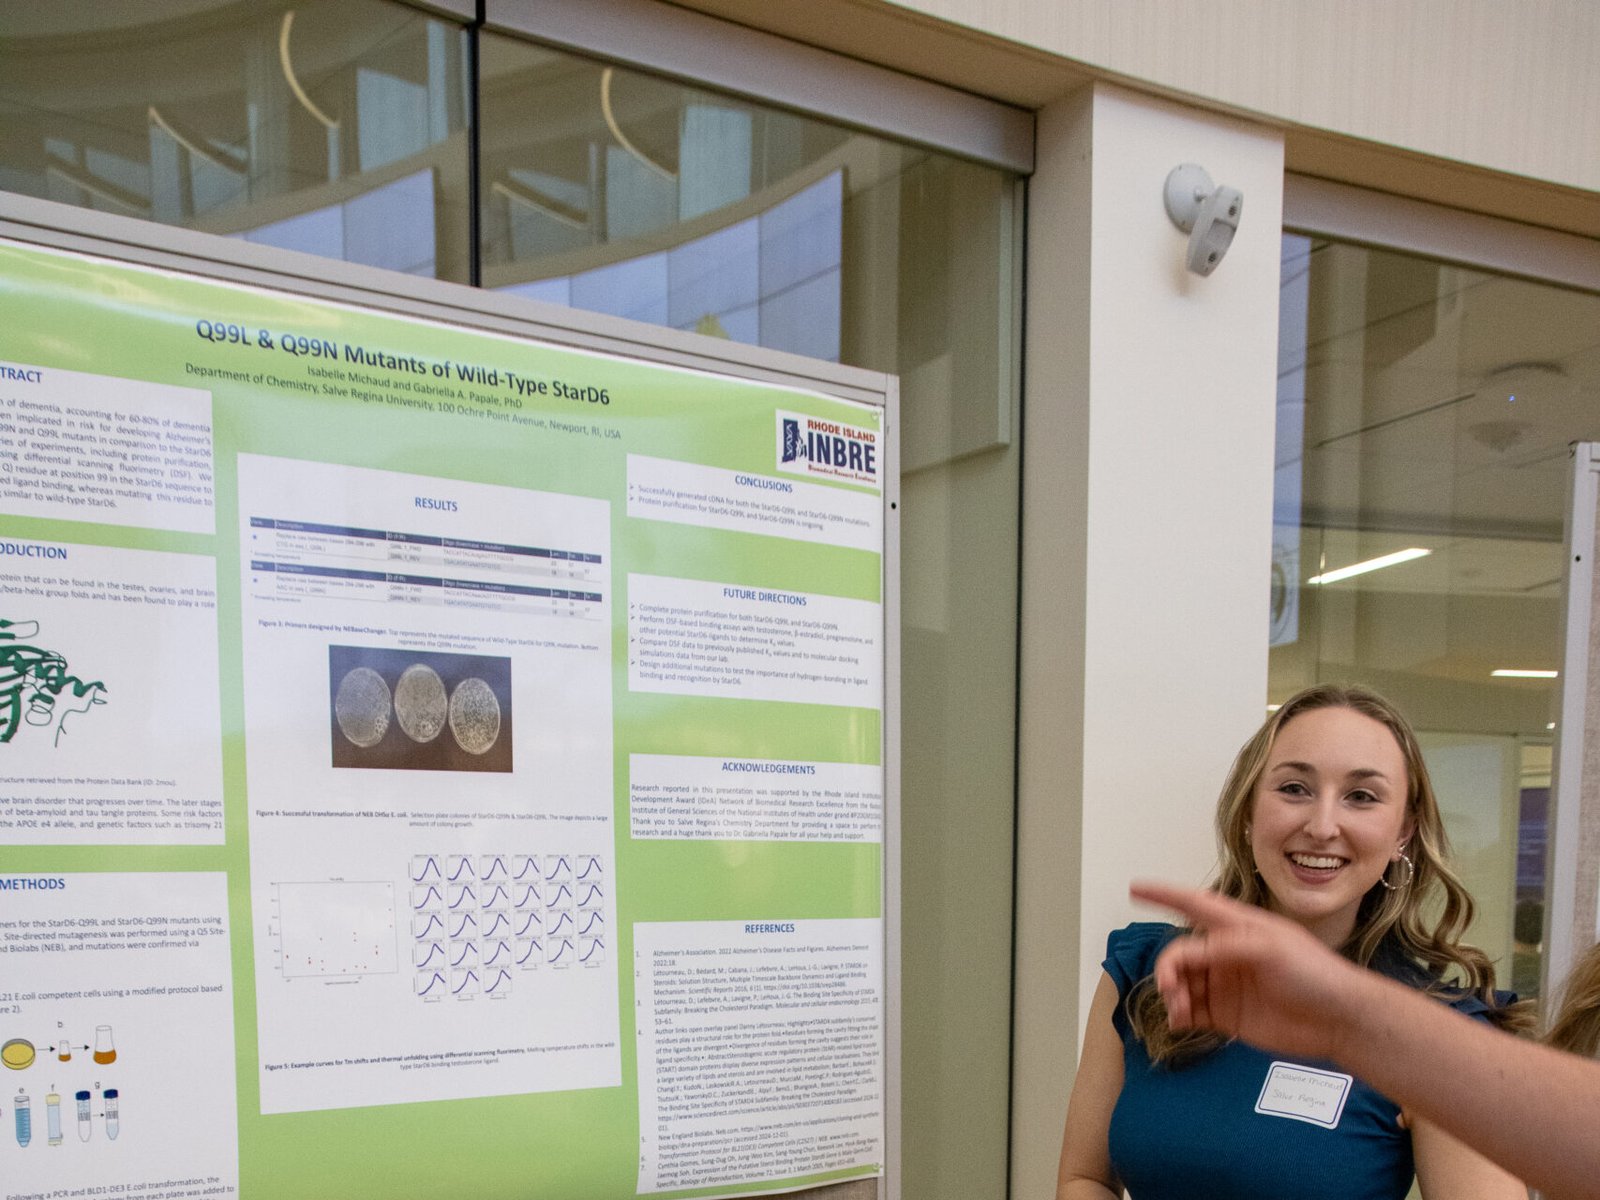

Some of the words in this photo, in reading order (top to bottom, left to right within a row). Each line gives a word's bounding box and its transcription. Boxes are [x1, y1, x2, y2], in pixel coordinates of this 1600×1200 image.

[196, 321, 252, 346] Q99L
[258, 331, 275, 350] &
[281, 335, 338, 361] Q99N
[344, 346, 427, 375] Mutants
[432, 362, 451, 379] of
[457, 365, 548, 397] Wild-Type
[553, 381, 610, 406] StarD6
[0, 367, 42, 383] TRACT
[307, 365, 346, 380] Isabelle
[348, 372, 391, 387] Michaud
[393, 381, 411, 390] and
[413, 382, 455, 397] Gabriella
[504, 396, 523, 408] PhD
[185, 364, 251, 383] Department
[253, 375, 264, 385] of
[323, 385, 349, 398] Salve
[351, 389, 384, 403] Regina
[438, 402, 456, 414] 100
[457, 405, 485, 418] Ochre
[487, 410, 510, 422] Point
[604, 428, 621, 439] USA
[7, 400, 16, 408] of
[66, 409, 112, 422] accounting
[114, 412, 126, 422] for
[129, 414, 160, 426] 60-80%
[162, 419, 171, 427] of
[173, 419, 211, 432] dementia
[808, 420, 841, 435] RHODE
[843, 428, 875, 442] ISLAND
[808, 431, 876, 474] INBRE
[735, 475, 793, 493] CONCLUSIONS
[4, 490, 32, 500] similar
[34, 493, 44, 501] to
[46, 494, 86, 506] wild-type
[415, 497, 458, 512] RESULTS
[24, 575, 41, 584] that
[59, 577, 70, 586] be
[72, 578, 95, 588] found
[97, 580, 105, 588] in
[107, 581, 120, 589] the
[180, 586, 194, 595] and
[196, 587, 215, 596] brain
[723, 588, 756, 601] FUTURE
[758, 592, 807, 606] DIRECTIONS
[722, 762, 816, 775] ACKNOWLEDGEMENTS
[5, 808, 14, 816] of
[16, 808, 67, 818] beta-amyloid
[101, 809, 125, 818] tangle
[161, 809, 182, 817] Some
[183, 809, 196, 817] risk
[198, 809, 222, 817] factors
[16, 820, 38, 828] APOE
[41, 820, 51, 828] e4
[96, 821, 124, 830] genetic
[154, 821, 172, 829] such
[184, 821, 211, 830] trisomy
[214, 821, 222, 829] 21
[0, 879, 65, 890] METHODS
[18, 919, 30, 927] for
[32, 918, 47, 927] the
[48, 917, 99, 927] StarD6-Q99L
[101, 917, 116, 925] and
[117, 916, 169, 925] StarD6-Q99N
[169, 916, 201, 924] mutants
[202, 915, 222, 925] using
[745, 923, 795, 933] REFERENCES
[4, 931, 57, 940] Site-directed
[58, 930, 108, 940] mutagenesis
[126, 928, 168, 939] performed
[169, 928, 190, 938] using
[197, 927, 208, 936] Q5
[210, 927, 226, 935] Site-
[10, 943, 39, 952] Biolabs
[69, 942, 84, 950] and
[85, 942, 125, 950] mutations
[148, 939, 187, 948] confirmed
[189, 939, 200, 947] via
[14, 991, 36, 1000] E.coli
[38, 990, 82, 1000] competent
[83, 989, 101, 997] cells
[102, 988, 124, 998] using
[132, 986, 166, 995] modified
[167, 985, 199, 996] protocol
[201, 984, 223, 993] based
[53, 1188, 69, 1198] PCR
[70, 1187, 86, 1196] and
[87, 1183, 125, 1195] BLD1-DE3
[126, 1181, 147, 1191] E.coli
[207, 1175, 220, 1184] the
[146, 1190, 165, 1200] each
[166, 1189, 185, 1200] plate
[202, 1184, 226, 1194] added
[226, 1184, 235, 1192] to
